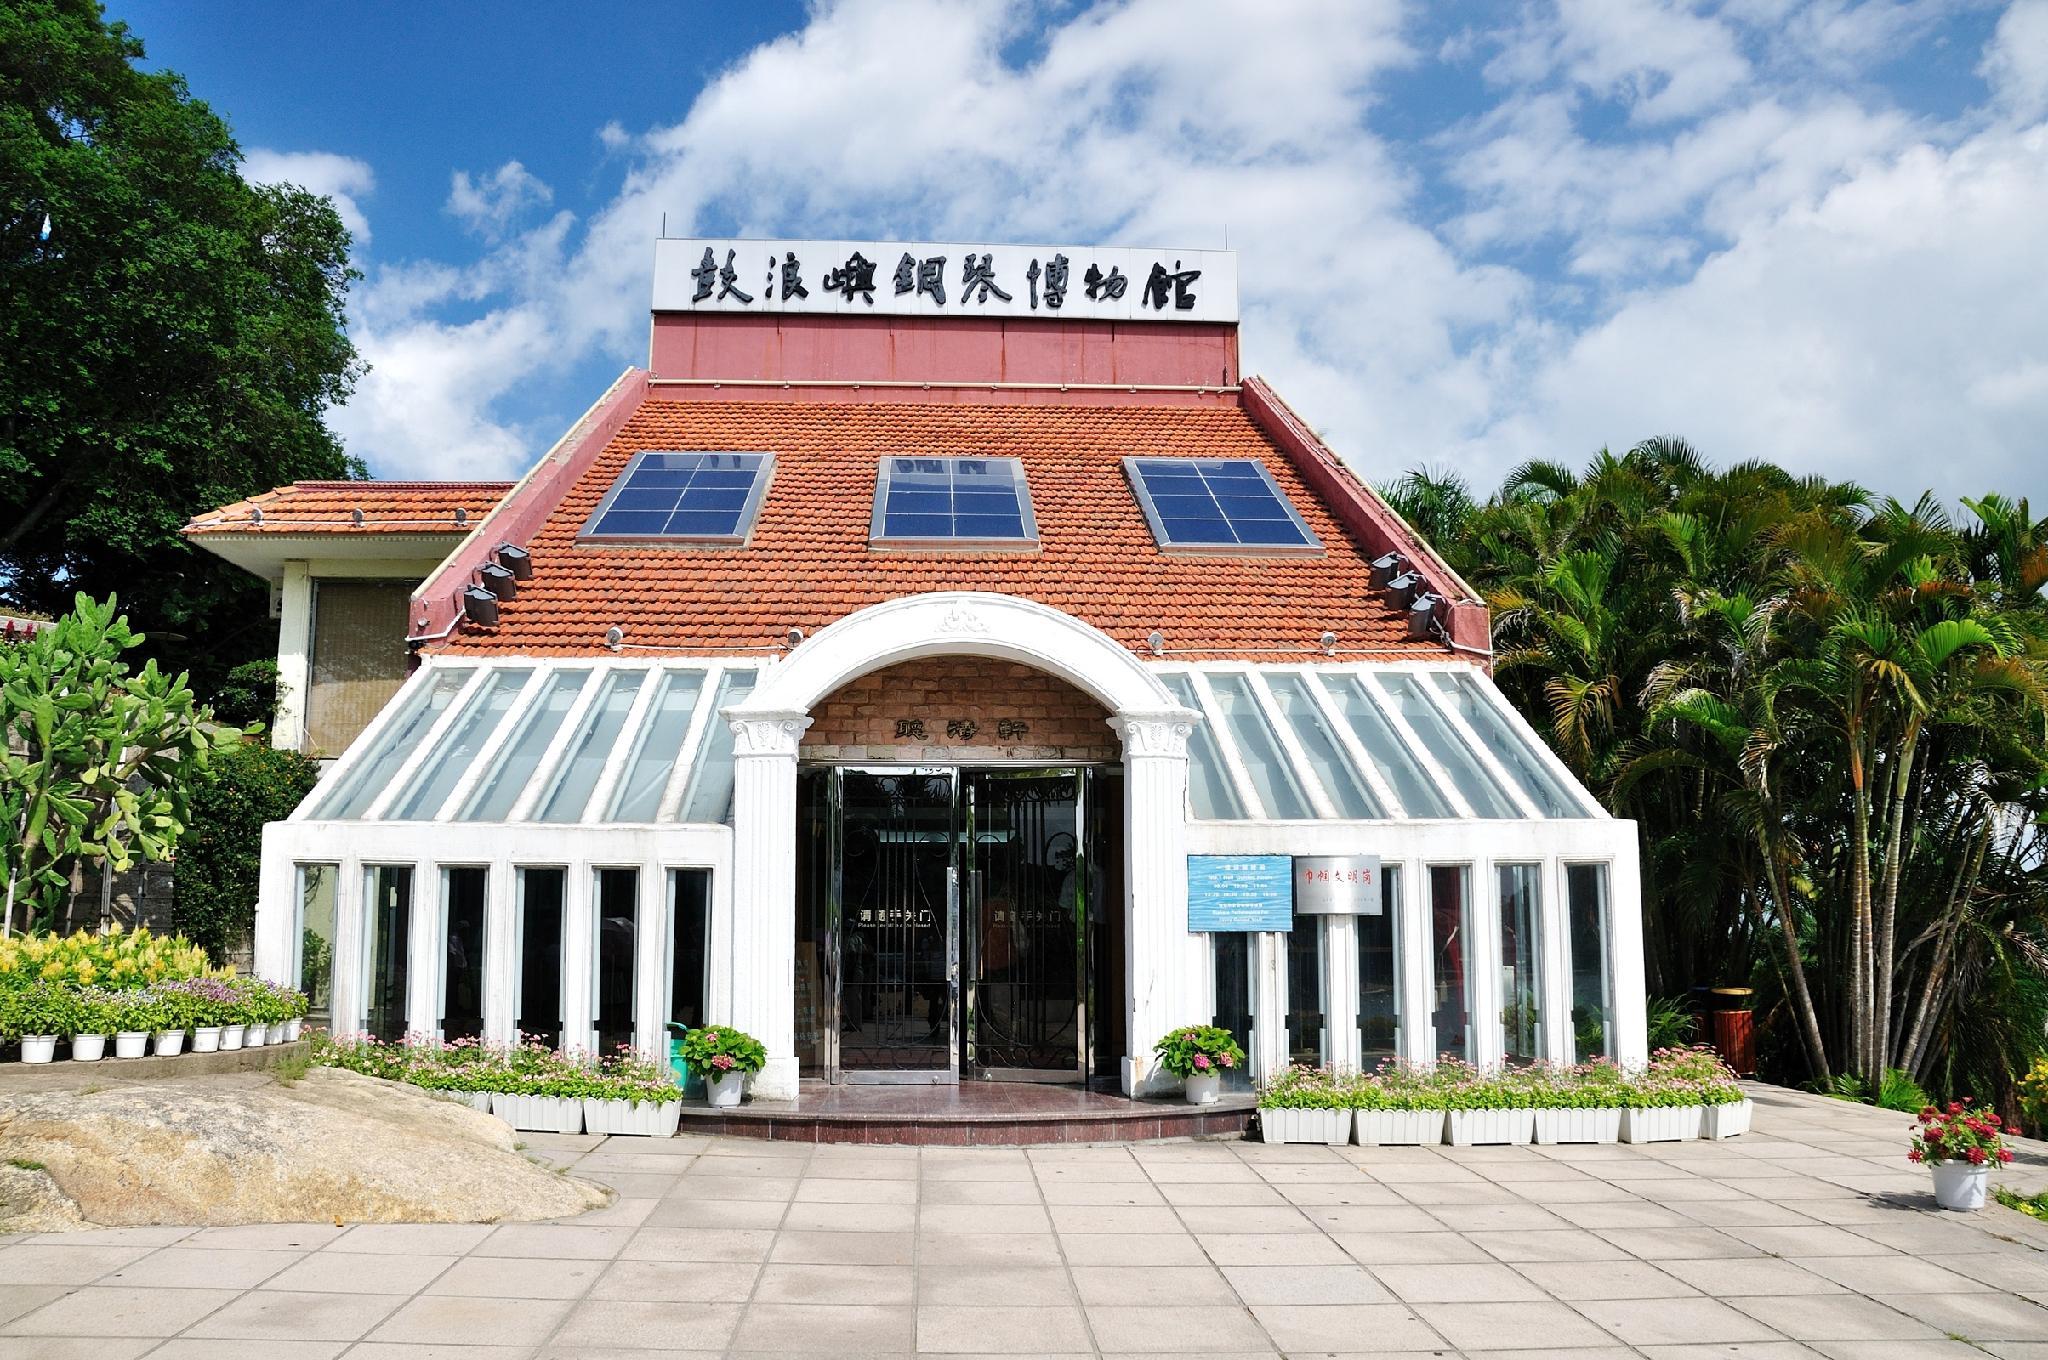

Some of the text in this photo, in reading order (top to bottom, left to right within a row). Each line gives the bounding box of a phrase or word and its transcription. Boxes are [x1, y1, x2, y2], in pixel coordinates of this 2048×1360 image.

[860, 909, 931, 922] 请随手关门
